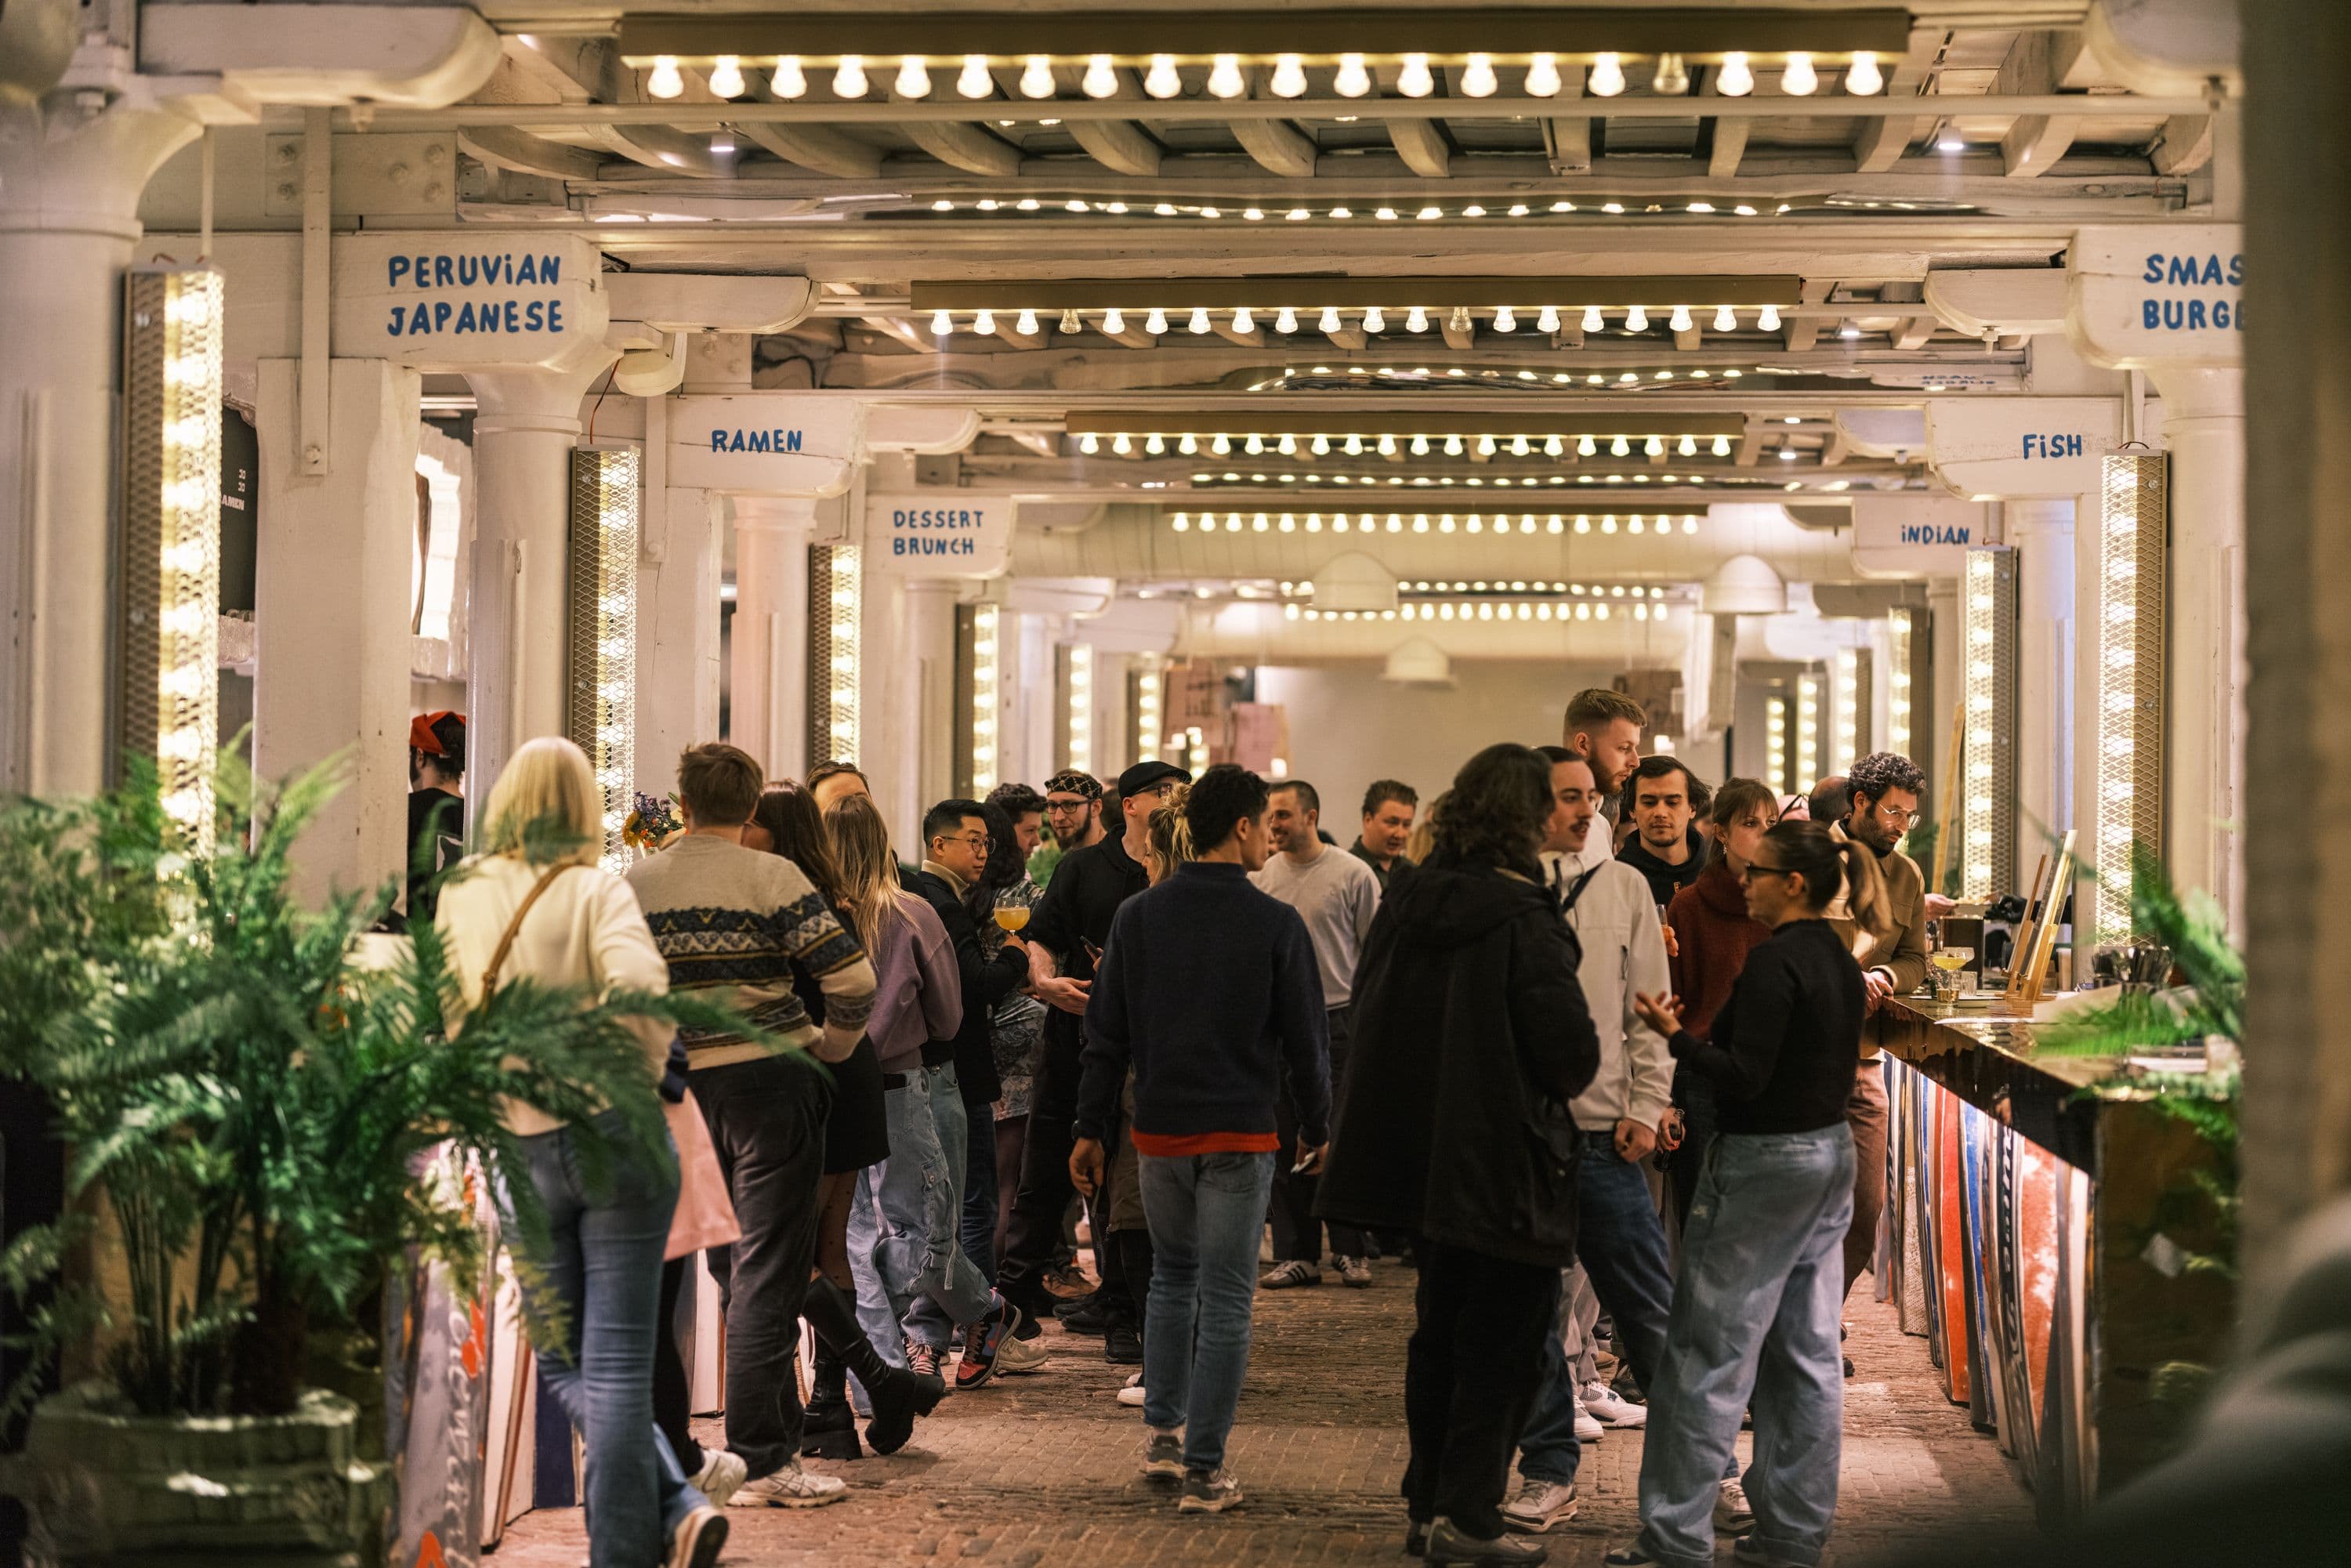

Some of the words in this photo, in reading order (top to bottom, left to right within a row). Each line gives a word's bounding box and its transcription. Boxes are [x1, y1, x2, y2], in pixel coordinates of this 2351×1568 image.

[2143, 253, 2246, 286] SMAS
[387, 299, 563, 336] JAPANESE
[711, 429, 802, 453] RAMEN
[221, 494, 245, 511] AMEN
[893, 510, 983, 529] DESSERT
[893, 537, 974, 556] BRUNCH
